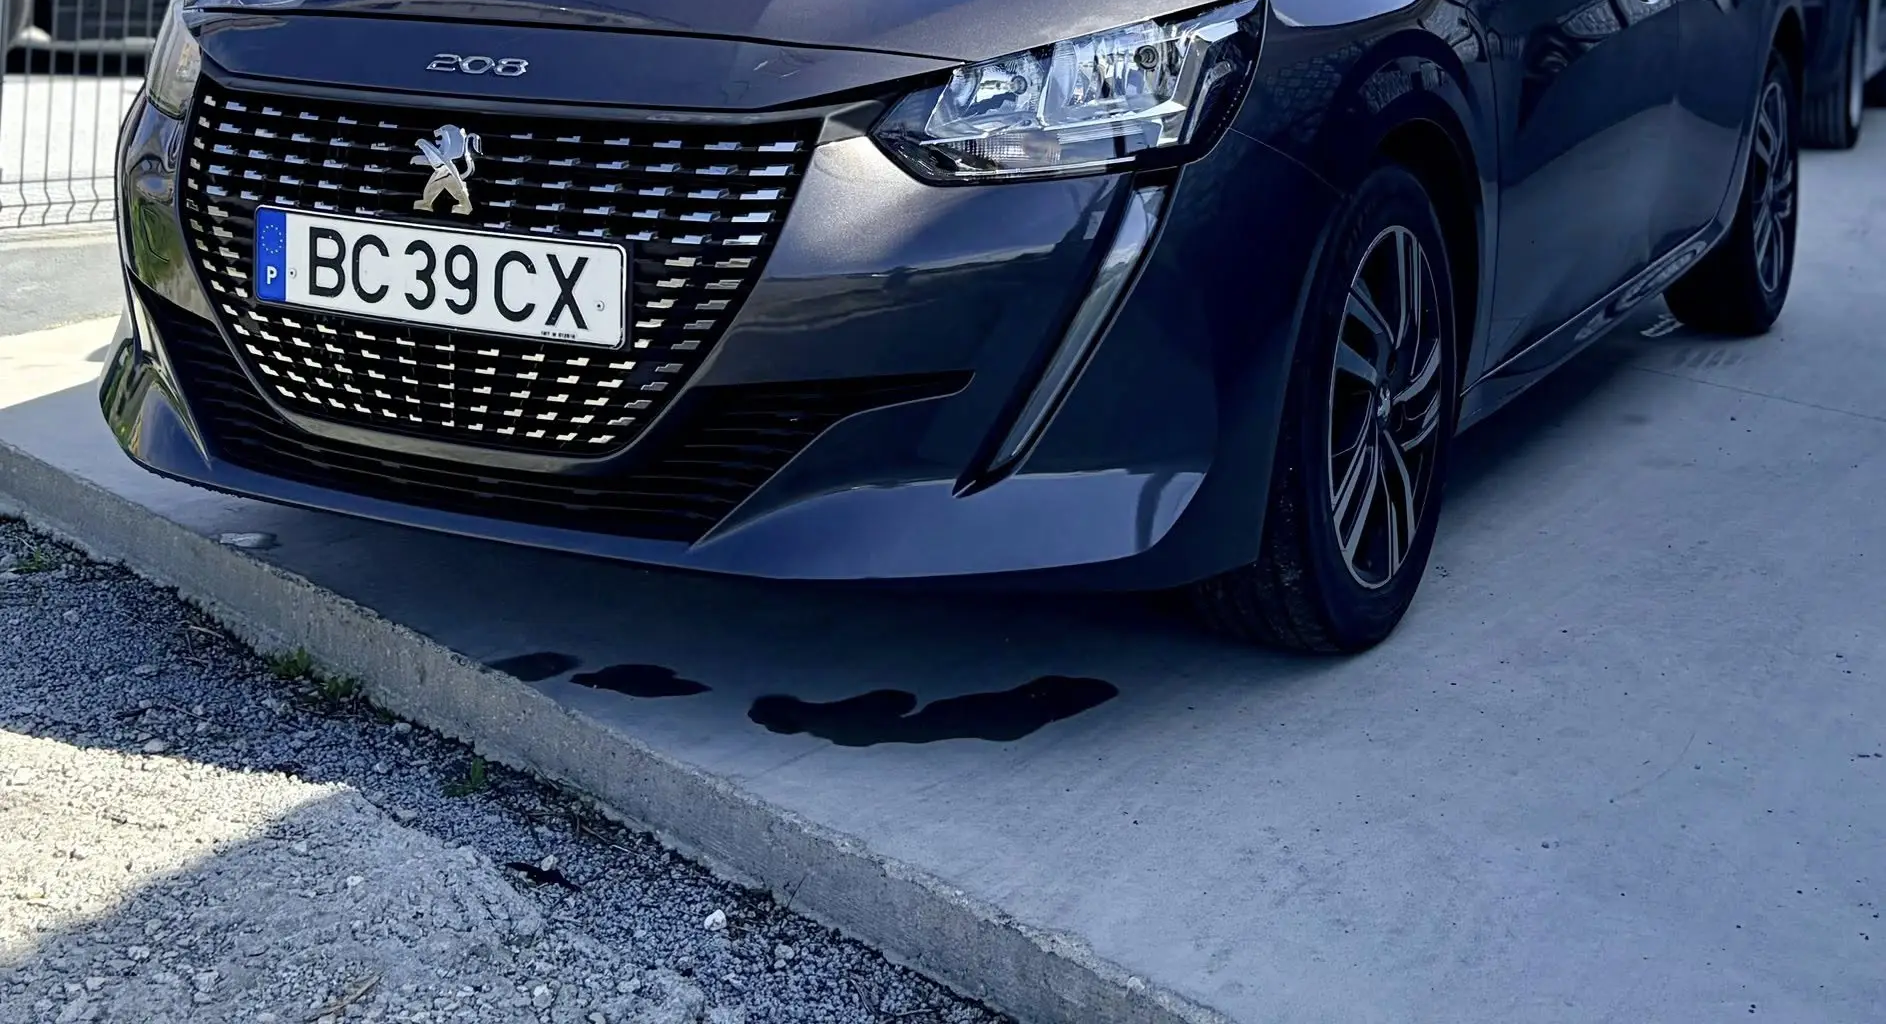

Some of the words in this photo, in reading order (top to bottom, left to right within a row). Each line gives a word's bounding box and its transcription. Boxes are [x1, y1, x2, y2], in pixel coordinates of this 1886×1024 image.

[426, 53, 529, 76] 208
[266, 265, 278, 285] P
[308, 225, 390, 304] BC
[404, 239, 479, 315] 39
[493, 250, 589, 330] CX
